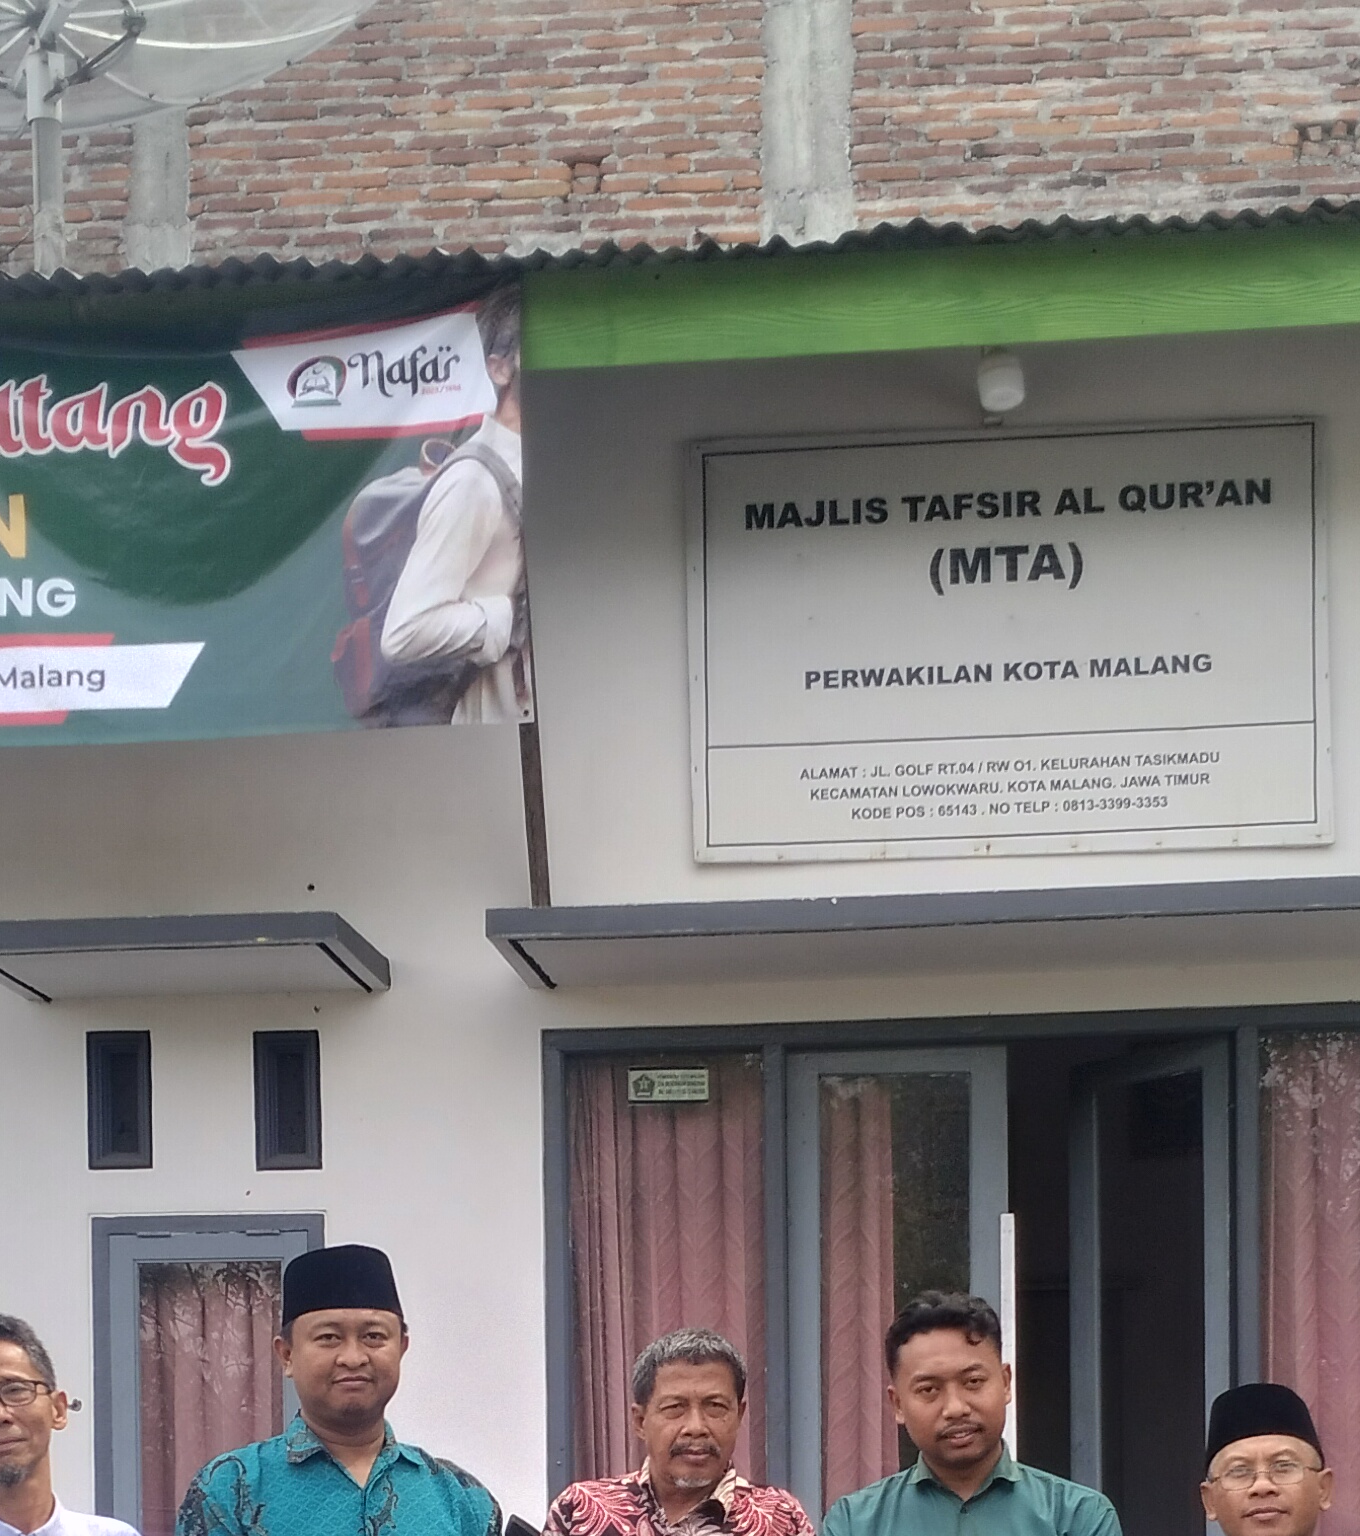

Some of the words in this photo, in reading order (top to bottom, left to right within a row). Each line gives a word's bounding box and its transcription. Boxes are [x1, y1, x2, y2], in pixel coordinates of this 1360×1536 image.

[743, 497, 890, 531] MAJLIS
[901, 488, 1042, 523] TAFSIR
[1054, 486, 1106, 516] AL
[1117, 477, 1273, 515] QUR’AN
[928, 541, 1085, 596] (MTA)
[803, 661, 993, 691] PERWAKILAN
[1002, 658, 1080, 684] KOTA
[1089, 652, 1213, 679] MALANG
[799, 766, 859, 781] ALAMAT
[894, 763, 934, 777] GOLF
[937, 761, 975, 776] RT.04
[977, 761, 983, 774] /
[986, 760, 1010, 773] RW
[1040, 755, 1131, 771] KELURAHAN
[1134, 751, 1221, 767] TASIKMADU
[810, 785, 898, 801] KECAMATAN
[1007, 780, 1047, 794] KOTA
[1120, 774, 1161, 789] JAWA
[1164, 772, 1211, 786] TIMUR
[851, 806, 892, 820] KODE
[895, 805, 926, 819] POS
[937, 803, 978, 817] 65143
[989, 802, 1011, 815] NO
[1014, 800, 1050, 814] TELP
[1062, 795, 1169, 812] 0813-3399-3353
